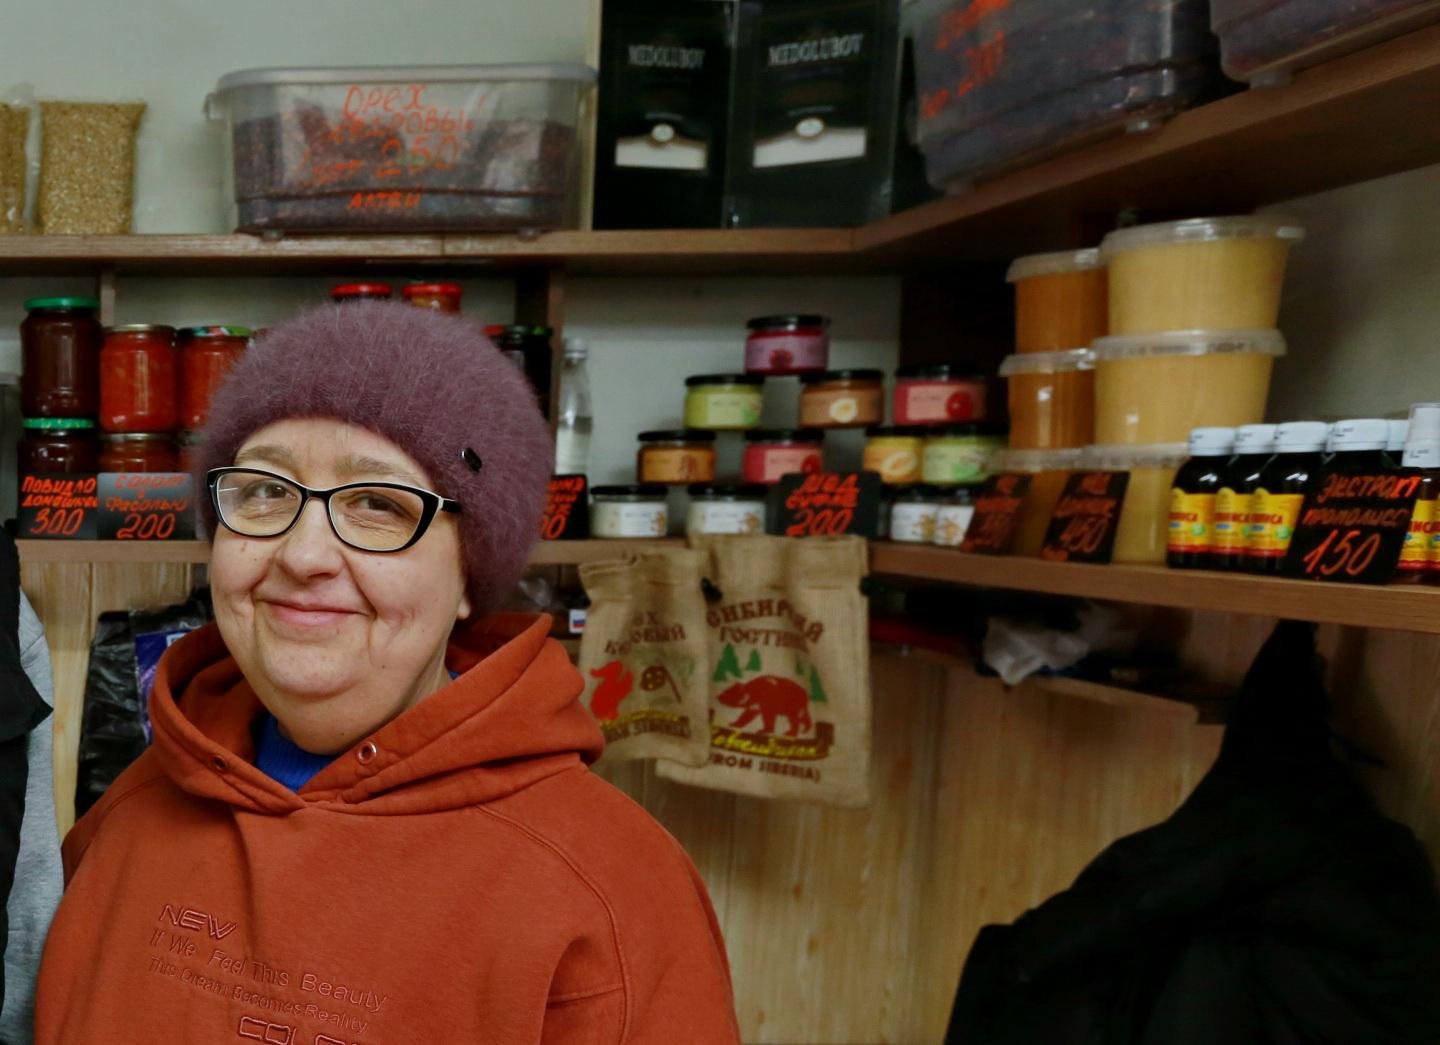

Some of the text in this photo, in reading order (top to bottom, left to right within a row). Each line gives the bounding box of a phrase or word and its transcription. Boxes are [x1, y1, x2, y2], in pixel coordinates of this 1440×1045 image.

[30, 508, 84, 535] 300
[116, 512, 176, 539] 200
[786, 509, 854, 537] 200
[1303, 529, 1381, 576] 150
[159, 904, 237, 939] NEW
[169, 935, 197, 957] We
[208, 950, 248, 975] Feel
[252, 961, 289, 986] This
[300, 974, 388, 1013] Beauty
[305, 1004, 368, 1034] Reality
